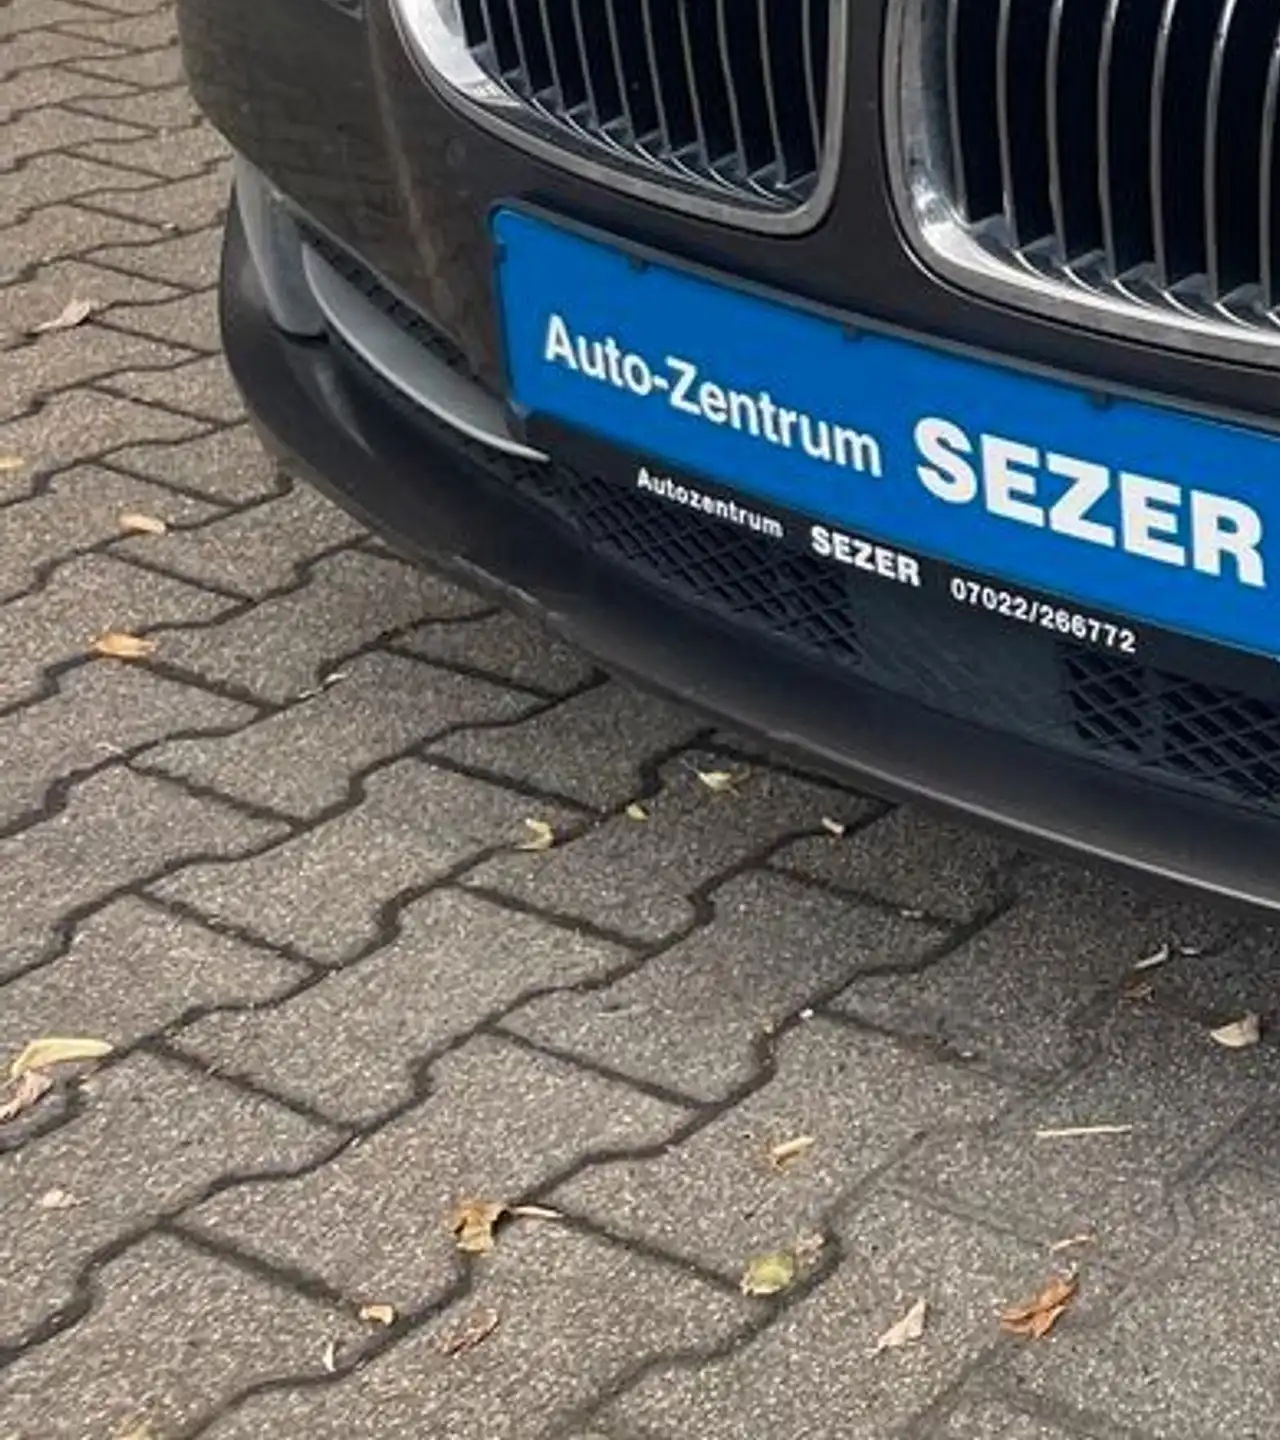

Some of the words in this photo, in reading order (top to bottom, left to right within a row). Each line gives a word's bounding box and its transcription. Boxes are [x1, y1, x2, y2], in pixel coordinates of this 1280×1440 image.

[544, 312, 884, 478] Auto-Zentrum
[913, 416, 1266, 588] SEZER
[637, 466, 784, 538] Autozentrum
[809, 524, 921, 588] SEZER
[949, 577, 1137, 654] 07022/266772
